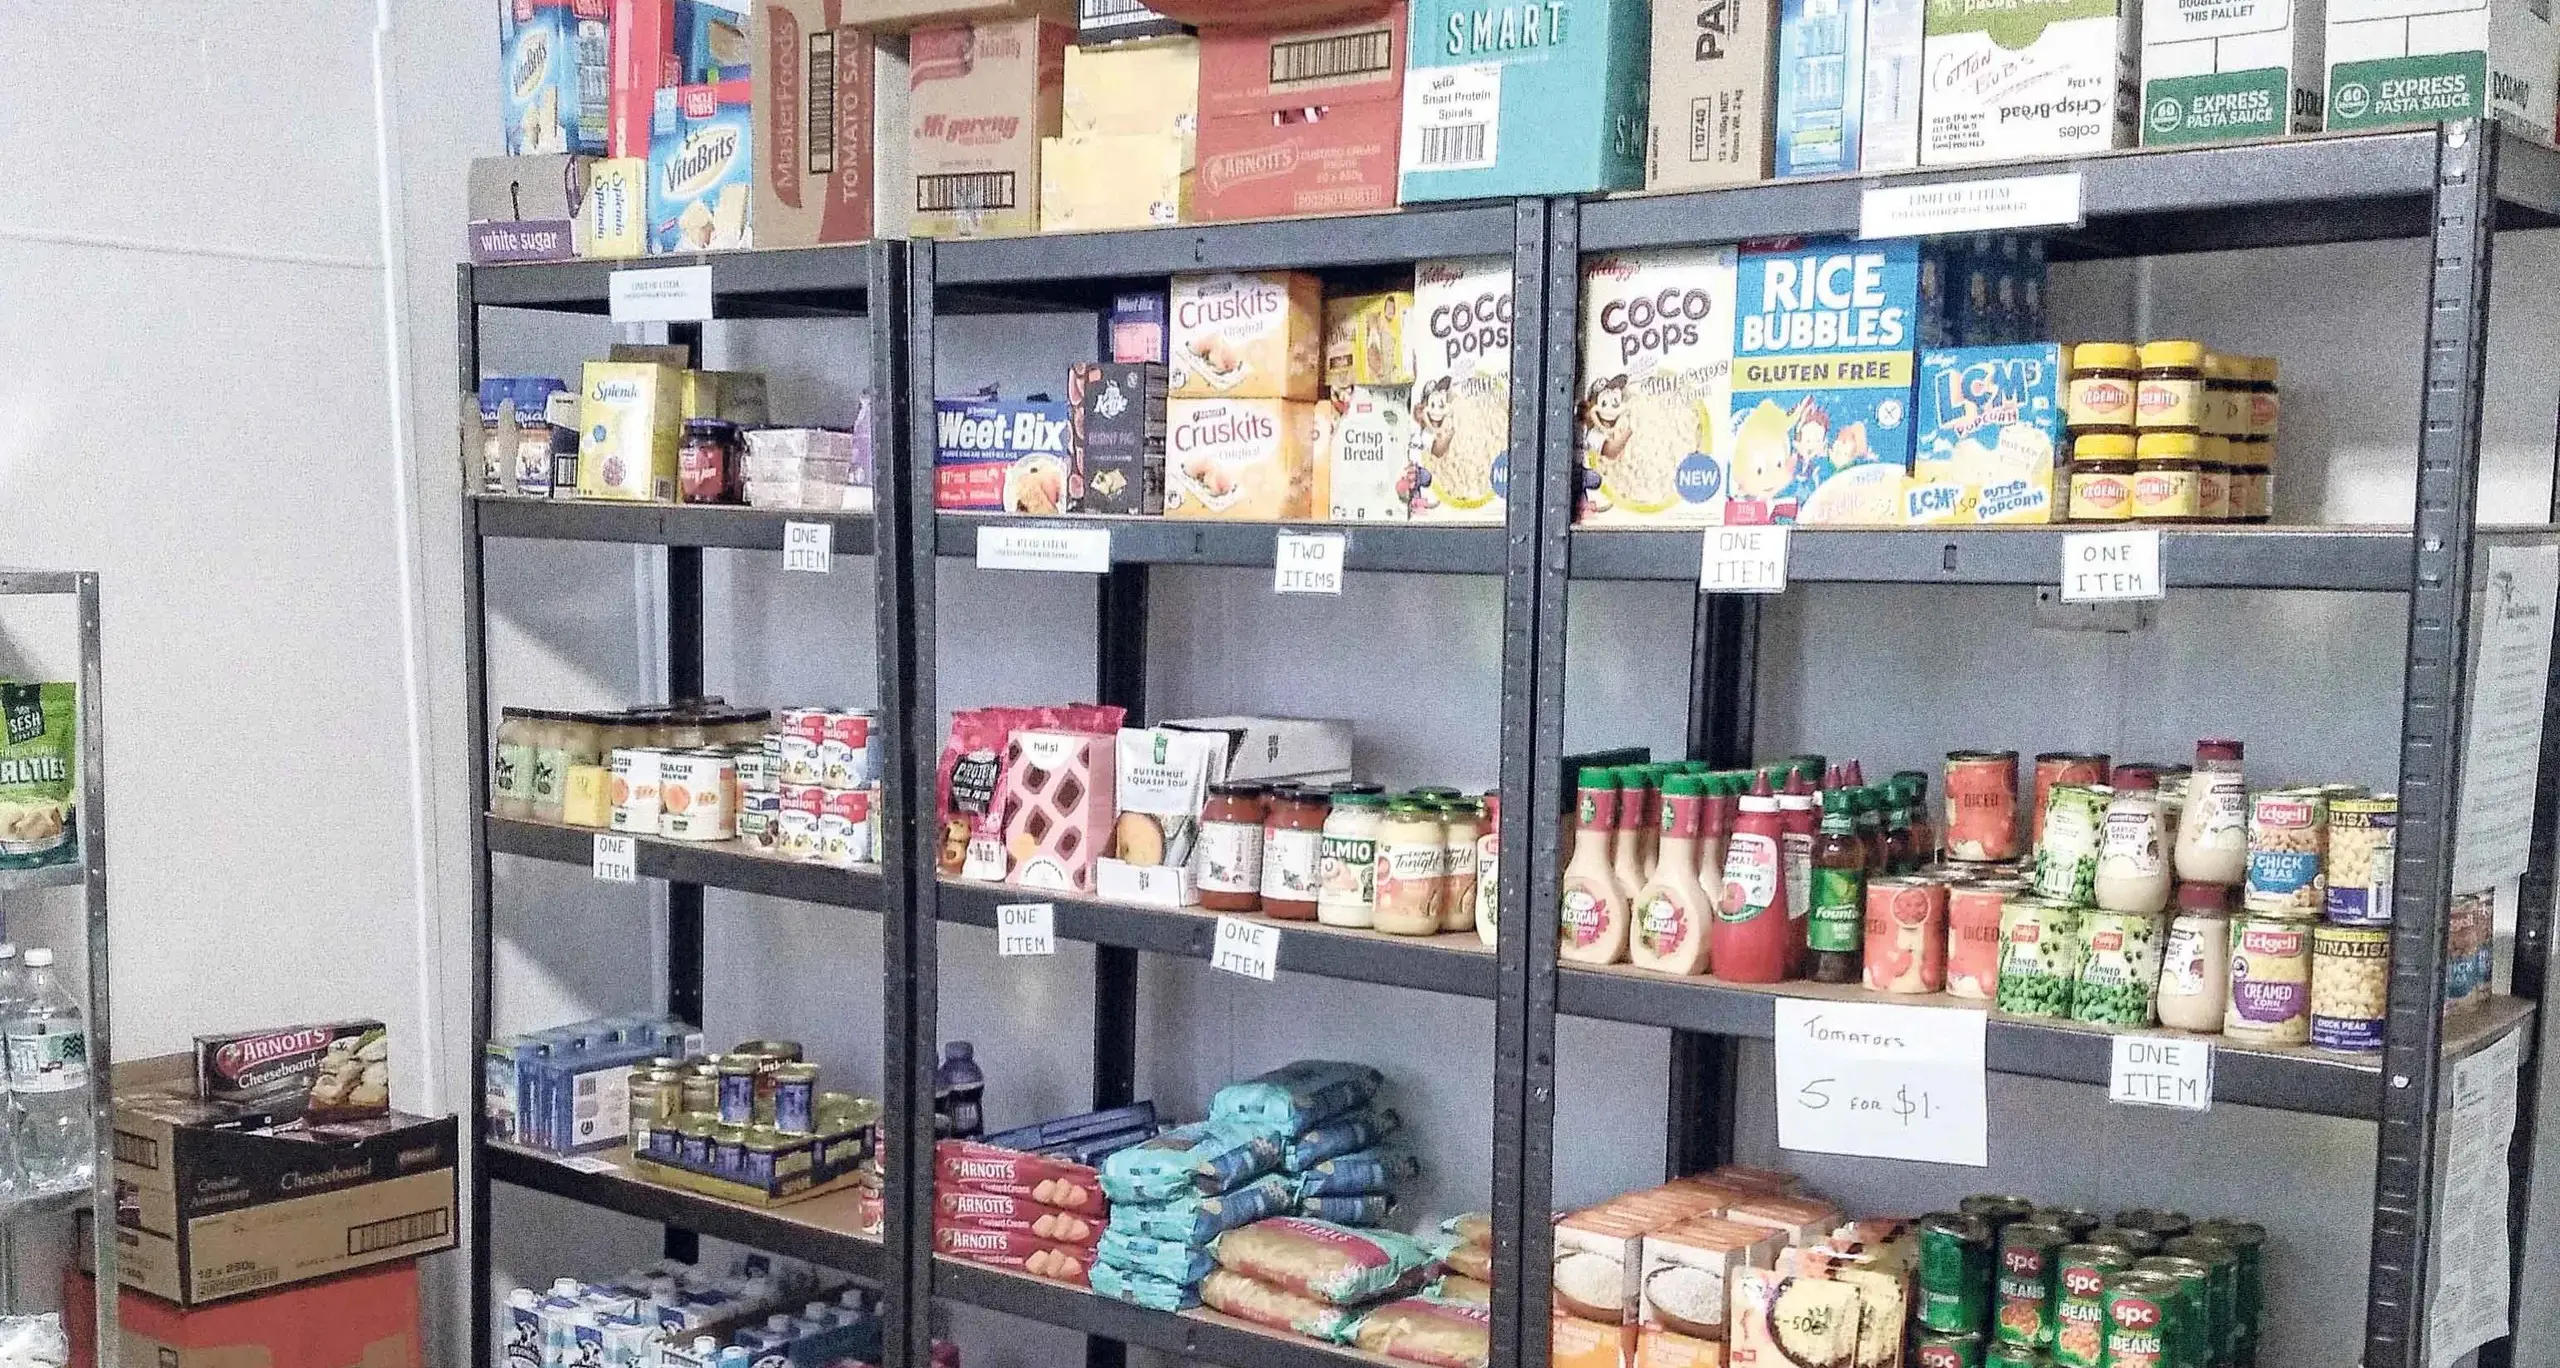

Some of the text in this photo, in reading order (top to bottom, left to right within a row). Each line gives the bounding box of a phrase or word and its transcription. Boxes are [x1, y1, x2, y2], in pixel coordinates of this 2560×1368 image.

[2184, 5, 2254, 23] THIS PALLET
[1449, 1, 1566, 54] SMART
[2343, 88, 2362, 102] 60
[2381, 74, 2467, 100] EXPRESS
[1423, 91, 1490, 105] Smart Protein
[2192, 90, 2270, 115] EXPRESS
[2375, 92, 2471, 115] PASTA SAUCE
[843, 29, 860, 203] TOMATO SAU
[1439, 109, 1473, 122] Spirals
[2000, 97, 2102, 125] Crisp Bread
[2157, 103, 2174, 117] 60
[2187, 108, 2273, 129] PASTA SAUCE
[2058, 123, 2101, 140] coles
[664, 134, 735, 192] VitaBrits
[1947, 190, 1962, 203] OF
[1978, 187, 2011, 201] ITEM
[480, 228, 558, 253] white sugar
[1764, 254, 1887, 314] RICE
[1178, 286, 1279, 330] Cruskits
[1223, 320, 1264, 339] Original
[1742, 307, 1905, 352] BUBBLES
[1446, 326, 1510, 368] pops
[1620, 321, 1699, 366] pops
[1747, 363, 1829, 384] GLUTEN
[1837, 360, 1891, 381] FREE
[2082, 388, 2128, 405] VEGEMITE
[937, 411, 1068, 451] Weet-Bix
[1175, 411, 1273, 452] Cruskits
[1954, 410, 2018, 436] POPCORN
[1344, 428, 1383, 446] Crisp
[1343, 445, 1384, 461] Bread
[1679, 470, 1718, 487] NEW
[1982, 478, 2028, 499] BUTTER
[2083, 484, 2129, 499] VEGEMITE
[1977, 490, 2044, 520] POPCORN
[792, 527, 819, 544] ONE
[1719, 531, 1763, 552] ONE
[788, 549, 827, 570] ITEM
[1289, 541, 1325, 561] TWO
[2083, 544, 2133, 563] ONE
[1282, 569, 1335, 589] ITEMS
[1712, 560, 1776, 584] ITEM
[2075, 573, 2143, 593] ITEM
[10, 712, 42, 733] SESH
[957, 762, 998, 779] PROTEIN
[1133, 767, 1185, 779] BUTTERNUT
[1127, 776, 1189, 789] SQUASH SOUP
[1964, 792, 1999, 808] DICED
[2258, 804, 2309, 825] Edgell
[599, 839, 626, 855] ONE
[1321, 839, 1371, 863] OLMIO
[598, 862, 630, 878] ITEM
[1395, 852, 1442, 875] Tonight
[2256, 855, 2303, 871] CHICK
[2263, 868, 2293, 879] PEAS
[1004, 907, 1038, 925] ONE
[1562, 908, 1600, 927] MEXICAN
[1643, 913, 1679, 935] MEXICAN
[1224, 921, 1265, 945] ONE
[1963, 926, 2000, 942] DICED
[1004, 936, 1046, 953] ITEM
[2245, 934, 2297, 953] Edgell
[1219, 952, 1265, 976] ITEM
[2243, 983, 2293, 1000] CREAMED
[2252, 999, 2282, 1008] CORN
[2317, 1018, 2367, 1031] CHICK PEAS
[2128, 1042, 2181, 1067] ONE
[237, 1055, 317, 1090] Cheeseboard
[1797, 1078, 1882, 1111] 5 FOR
[2121, 1073, 2197, 1104] ITEM
[280, 1157, 372, 1191] Cheeseboard
[2006, 1251, 2039, 1273] spc
[198, 1269, 213, 1281] 12
[2066, 1271, 2101, 1293] spc
[2002, 1279, 2046, 1301] BEANS
[2115, 1305, 2153, 1325] spc
[2112, 1335, 2161, 1355] BEANS
[1922, 1350, 1956, 1368] spc
